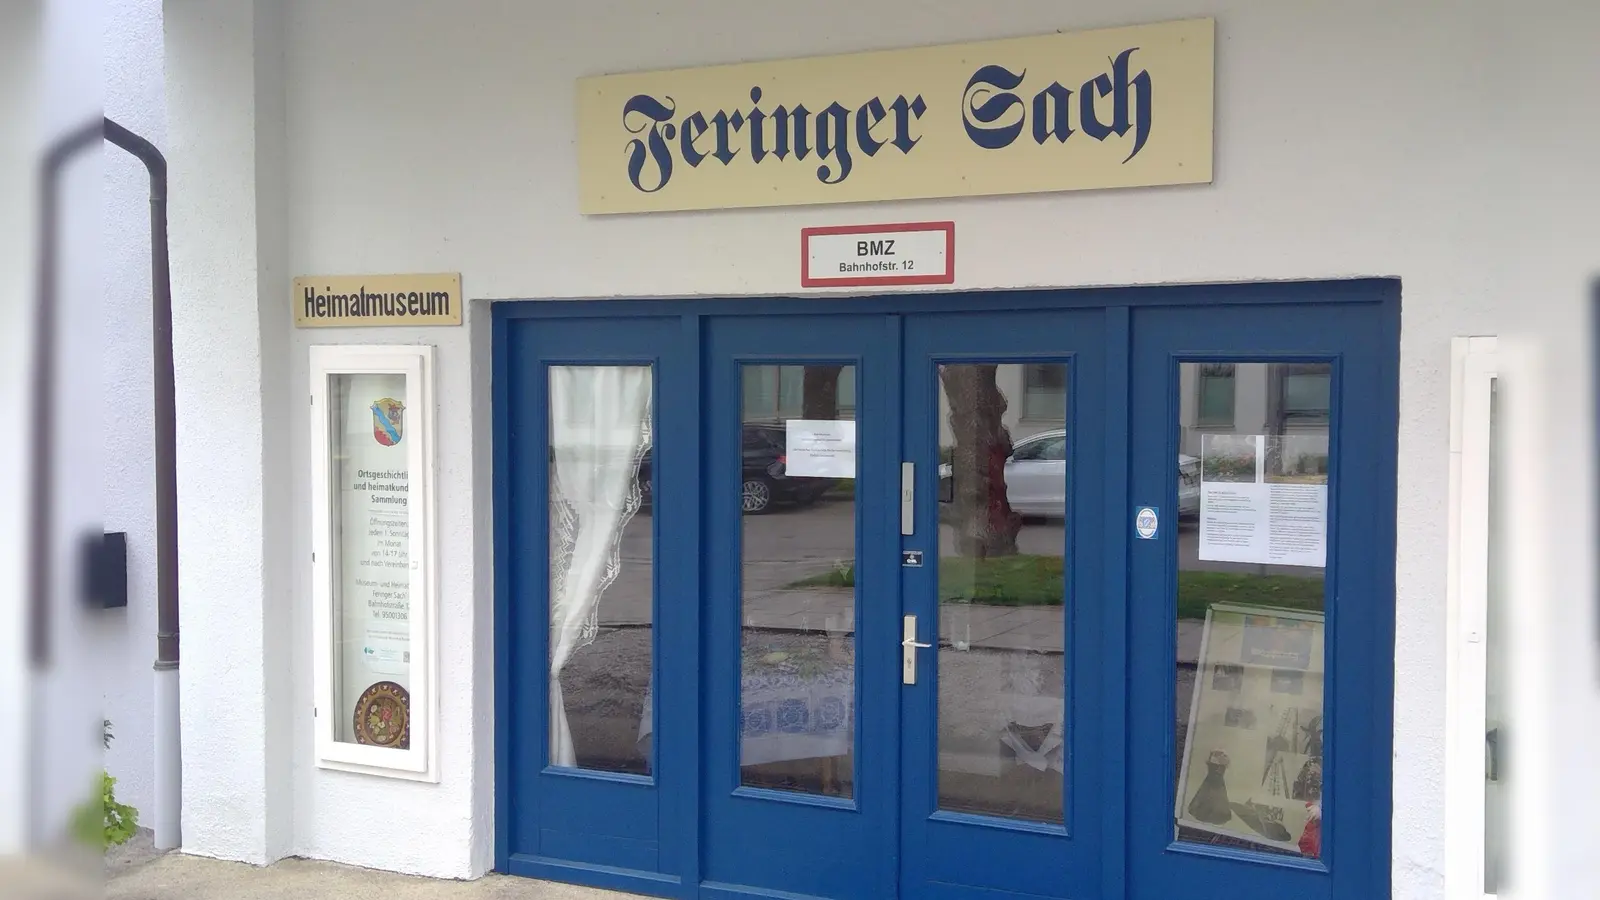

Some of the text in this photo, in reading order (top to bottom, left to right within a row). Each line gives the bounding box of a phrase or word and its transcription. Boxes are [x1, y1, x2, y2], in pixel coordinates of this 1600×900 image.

[622, 47, 1152, 193] Feringer Sach
[857, 240, 896, 257] BMZ
[839, 260, 914, 272] Bahnhofstr. 12
[304, 285, 450, 318] Heimatmuseum
[353, 482, 366, 490] und
[371, 494, 407, 506] Sammlung
